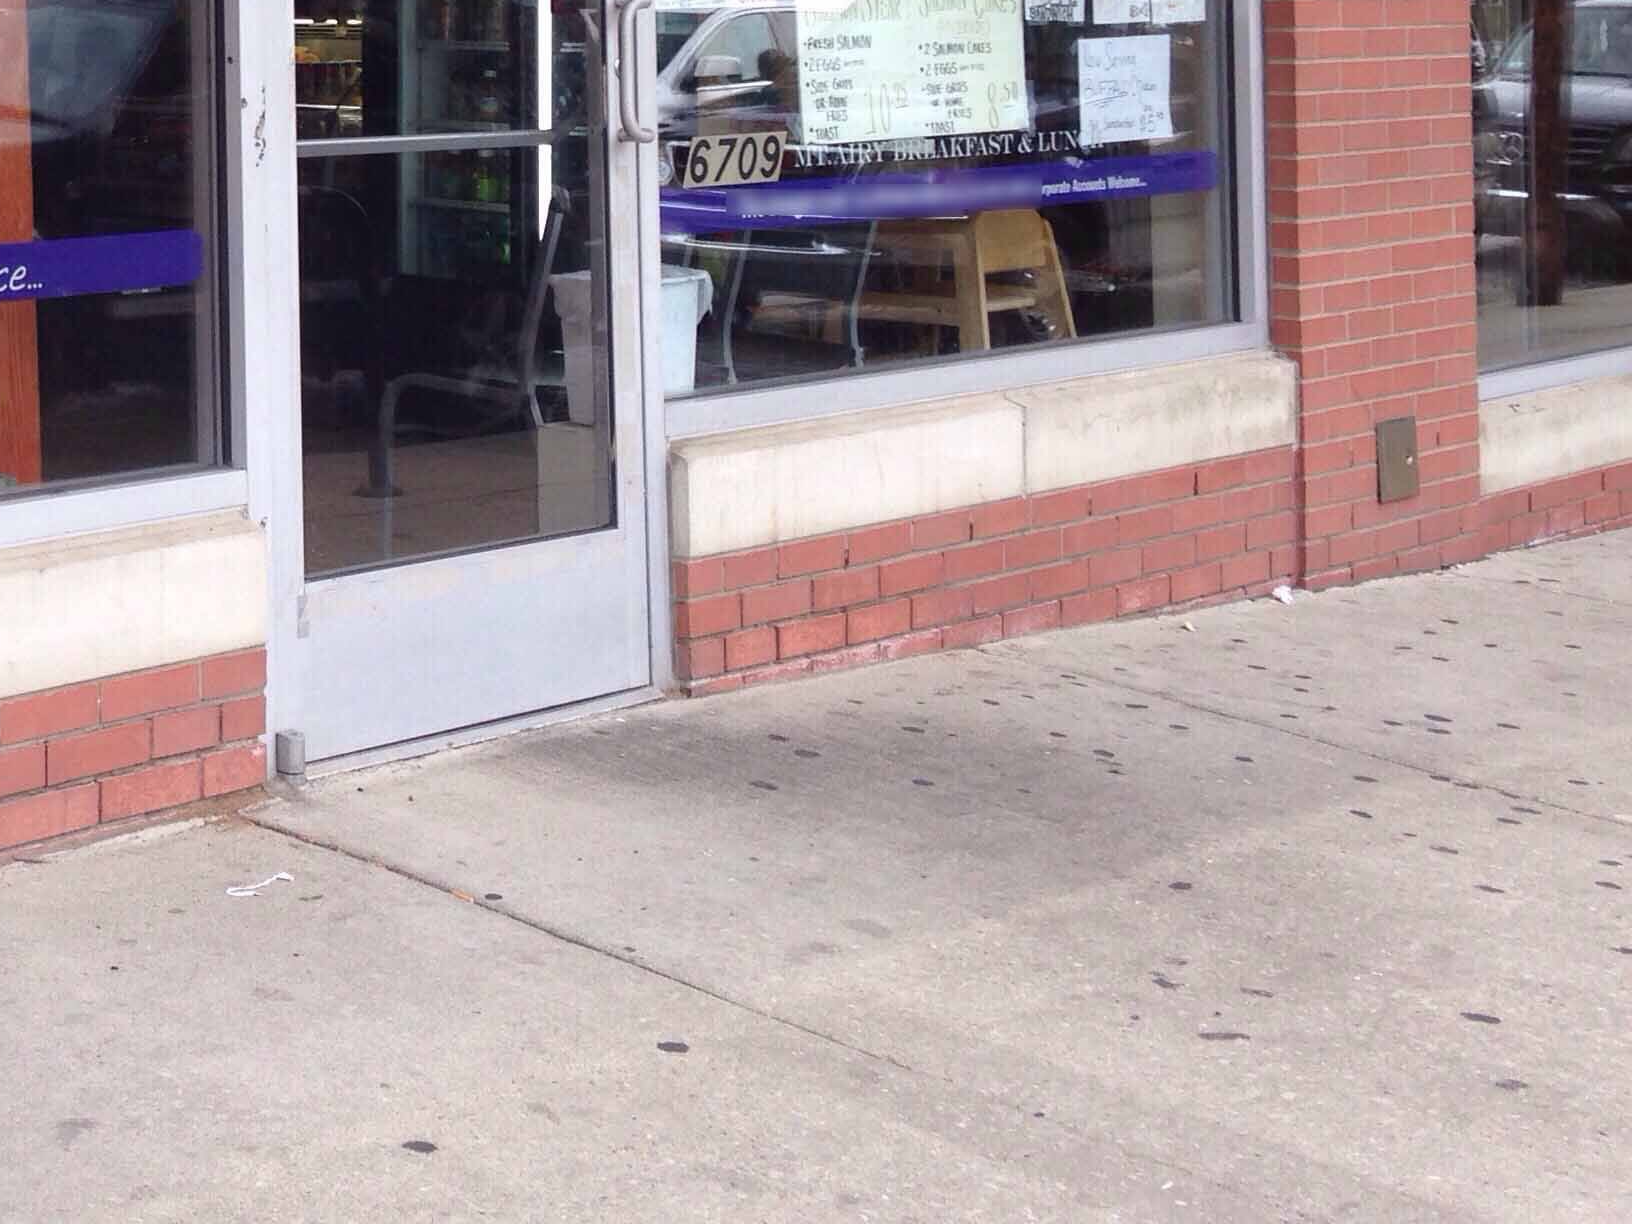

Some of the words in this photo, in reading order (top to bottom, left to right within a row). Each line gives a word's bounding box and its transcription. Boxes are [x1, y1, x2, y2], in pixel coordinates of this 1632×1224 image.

[689, 135, 781, 184] 6709
[1018, 134, 1033, 154] &
[1038, 129, 1105, 153] LUN
